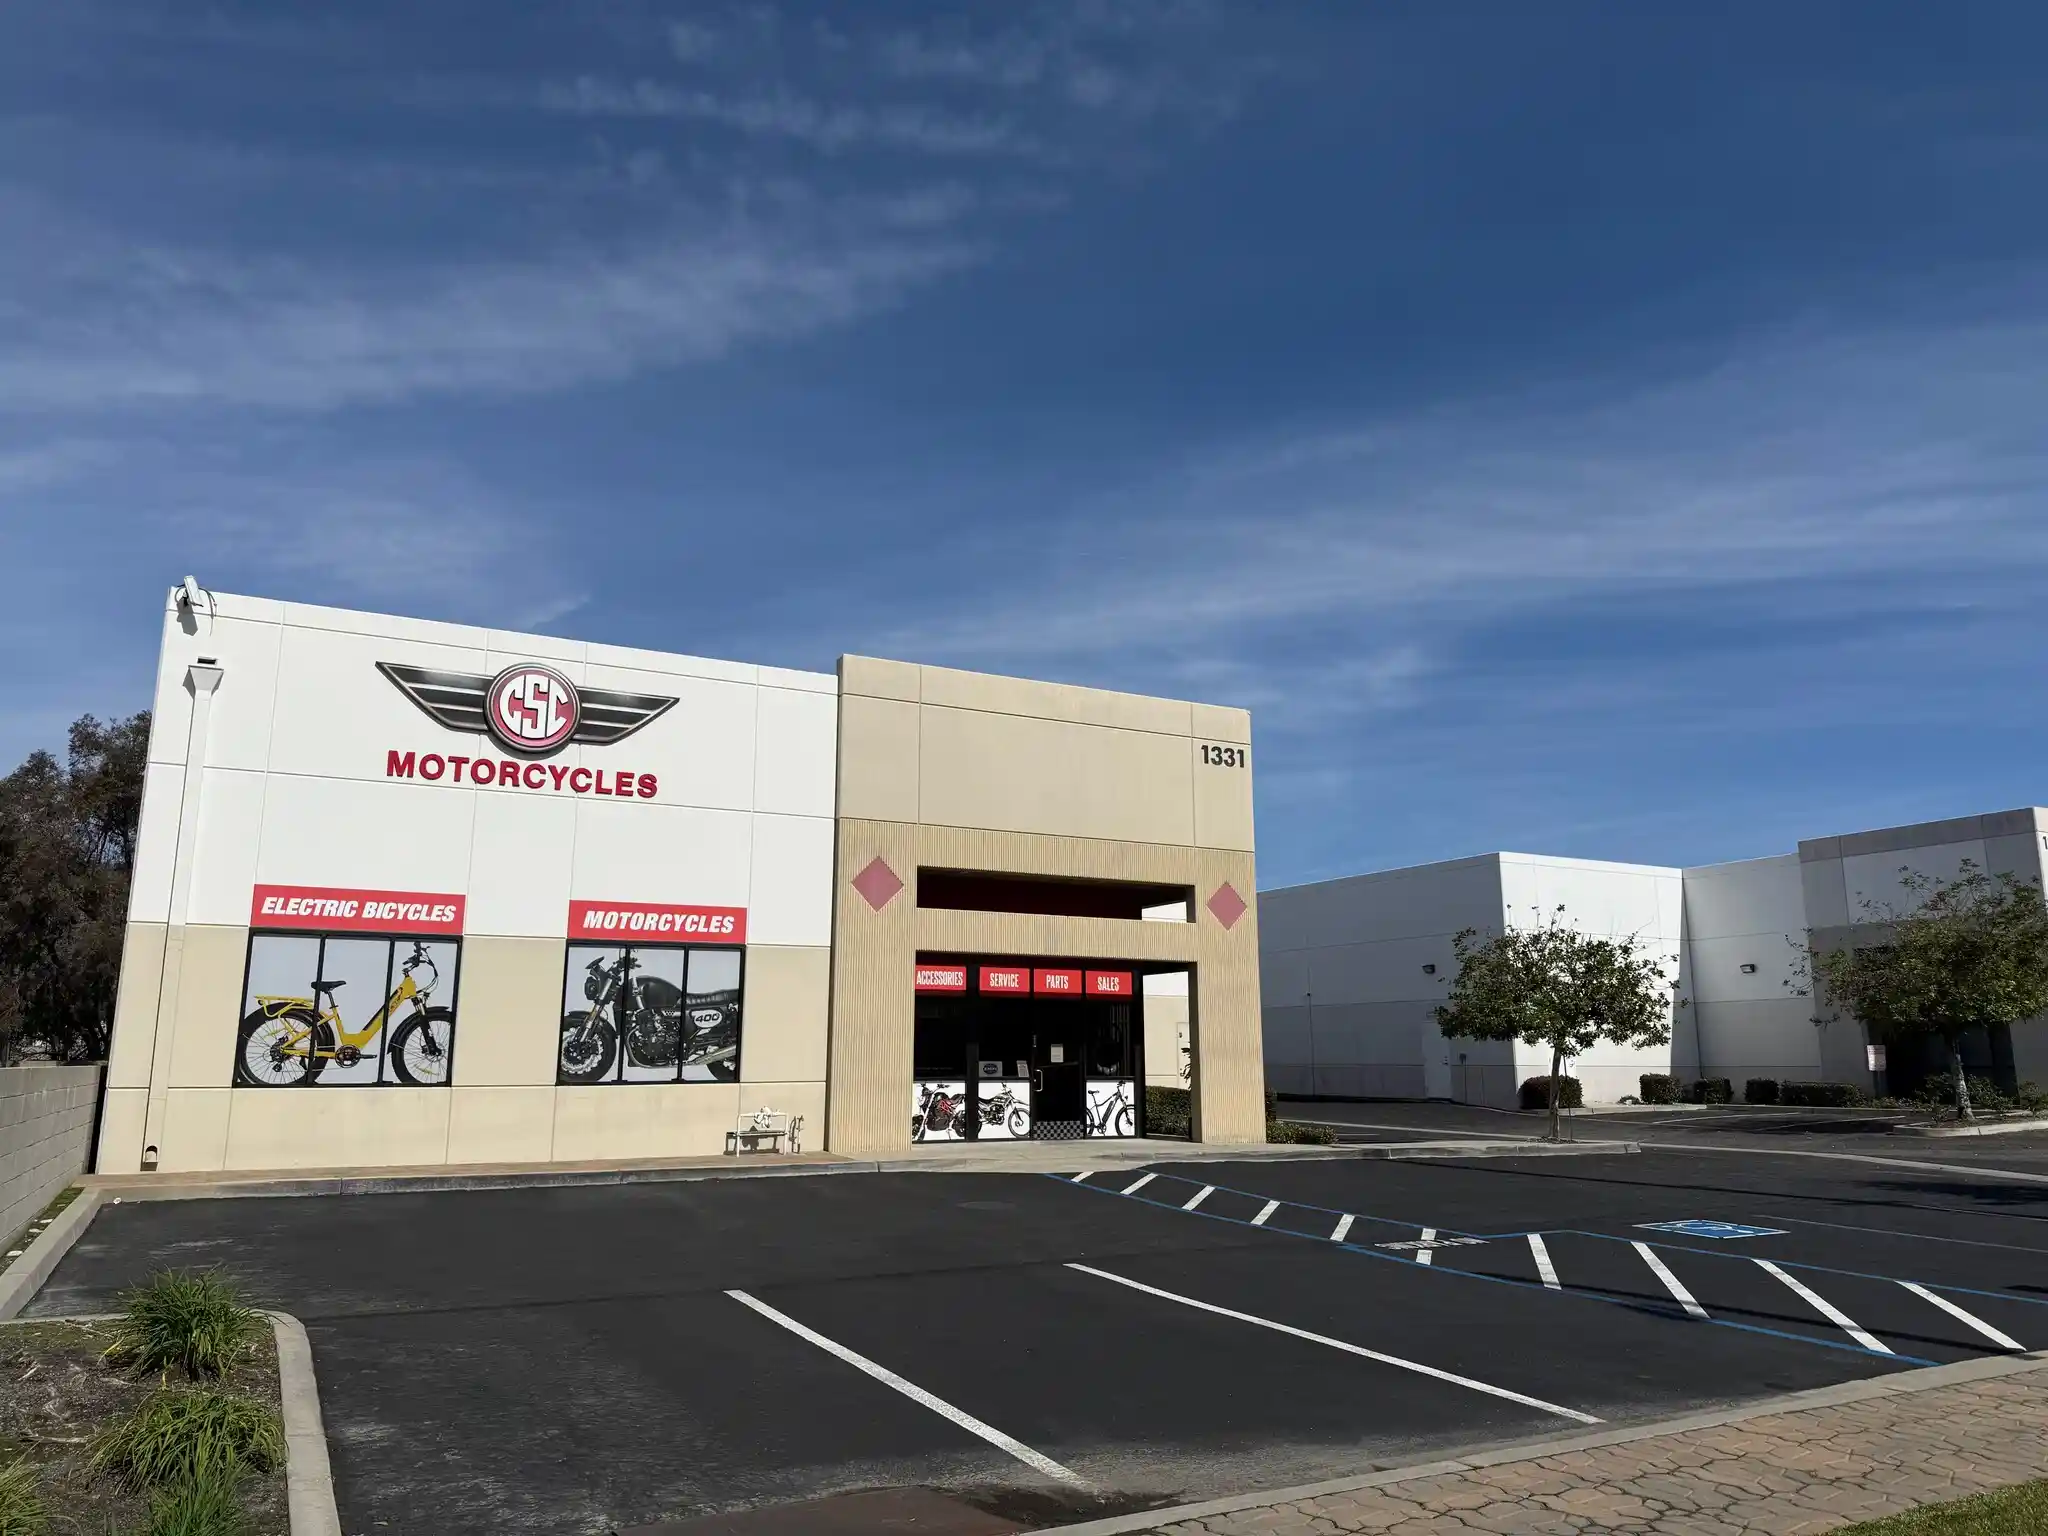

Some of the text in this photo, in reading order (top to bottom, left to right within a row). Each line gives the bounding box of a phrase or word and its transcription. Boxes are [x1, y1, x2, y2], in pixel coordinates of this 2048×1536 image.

[499, 674, 569, 739] CSC
[1201, 744, 1245, 768] 1331
[386, 749, 658, 799] MOTORCYCLES
[261, 896, 457, 922] ELECTRIC BICYCLES
[583, 910, 735, 934] MOTORCYCLES
[916, 970, 963, 986] ACCESSORIES
[989, 972, 1019, 988] SERVICE
[1046, 974, 1069, 990] PARTS
[1097, 976, 1120, 992] SALES
[695, 1013, 720, 1022] 400
